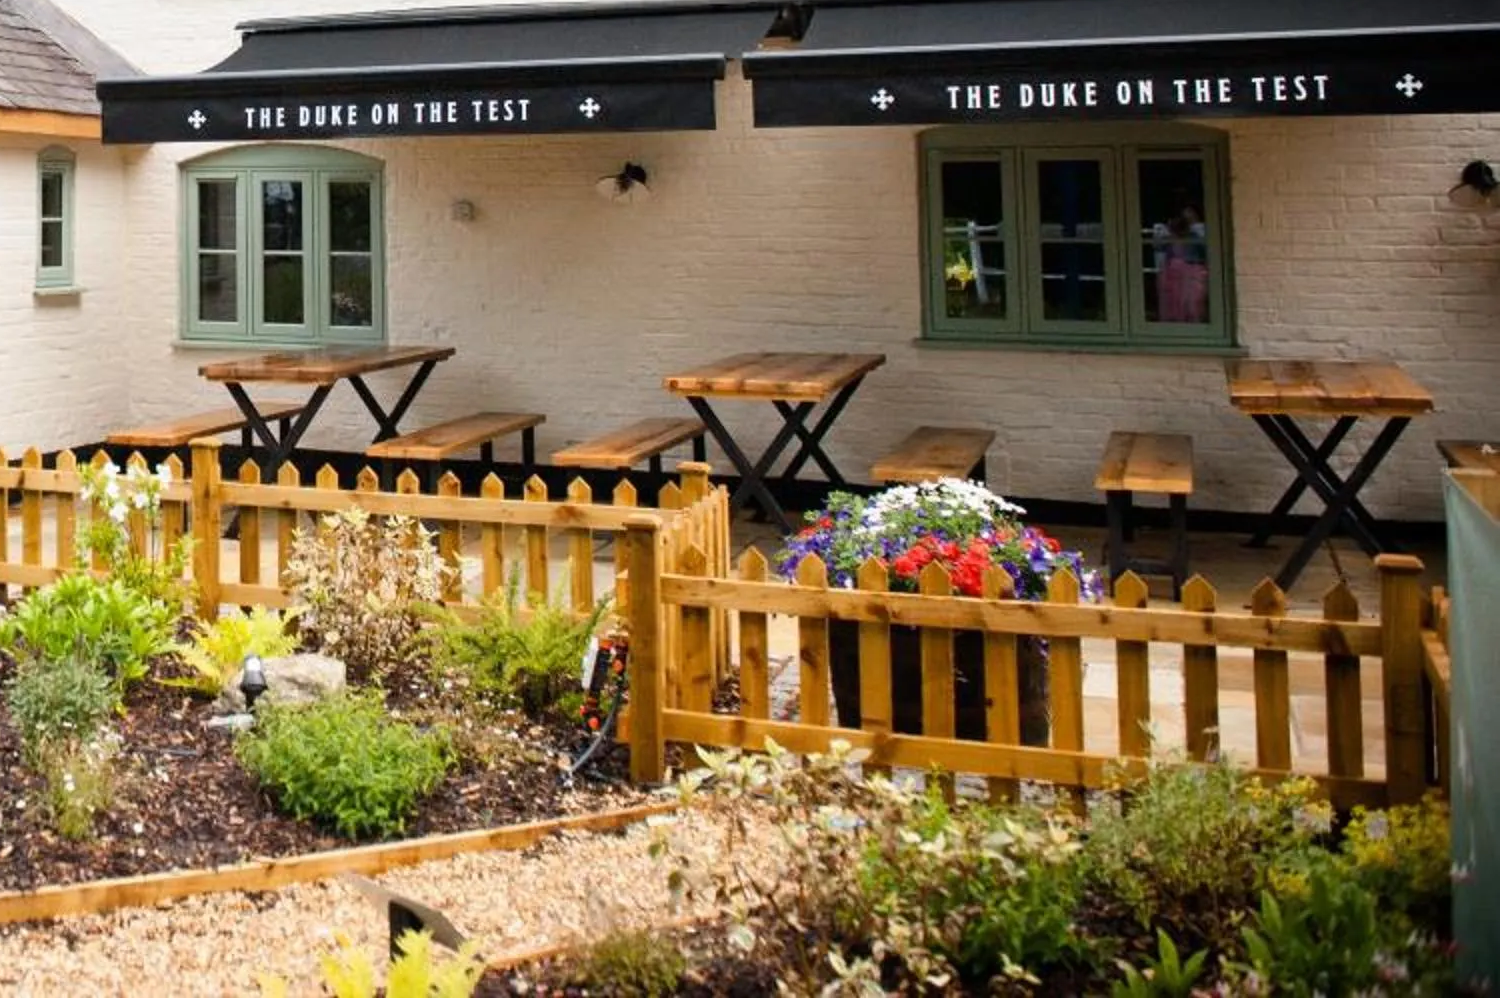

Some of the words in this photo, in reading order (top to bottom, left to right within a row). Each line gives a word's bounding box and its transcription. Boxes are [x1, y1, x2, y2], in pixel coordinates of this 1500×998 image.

[947, 84, 1000, 110] THE
[1019, 81, 1098, 108] DUKE
[1116, 79, 1155, 106] ON
[1173, 76, 1232, 105] THE
[1251, 74, 1329, 102] TEST
[245, 107, 286, 129] THE
[299, 105, 357, 128] DUKE
[371, 103, 399, 126] ON
[414, 101, 458, 124] THE
[471, 99, 531, 123] TEST
